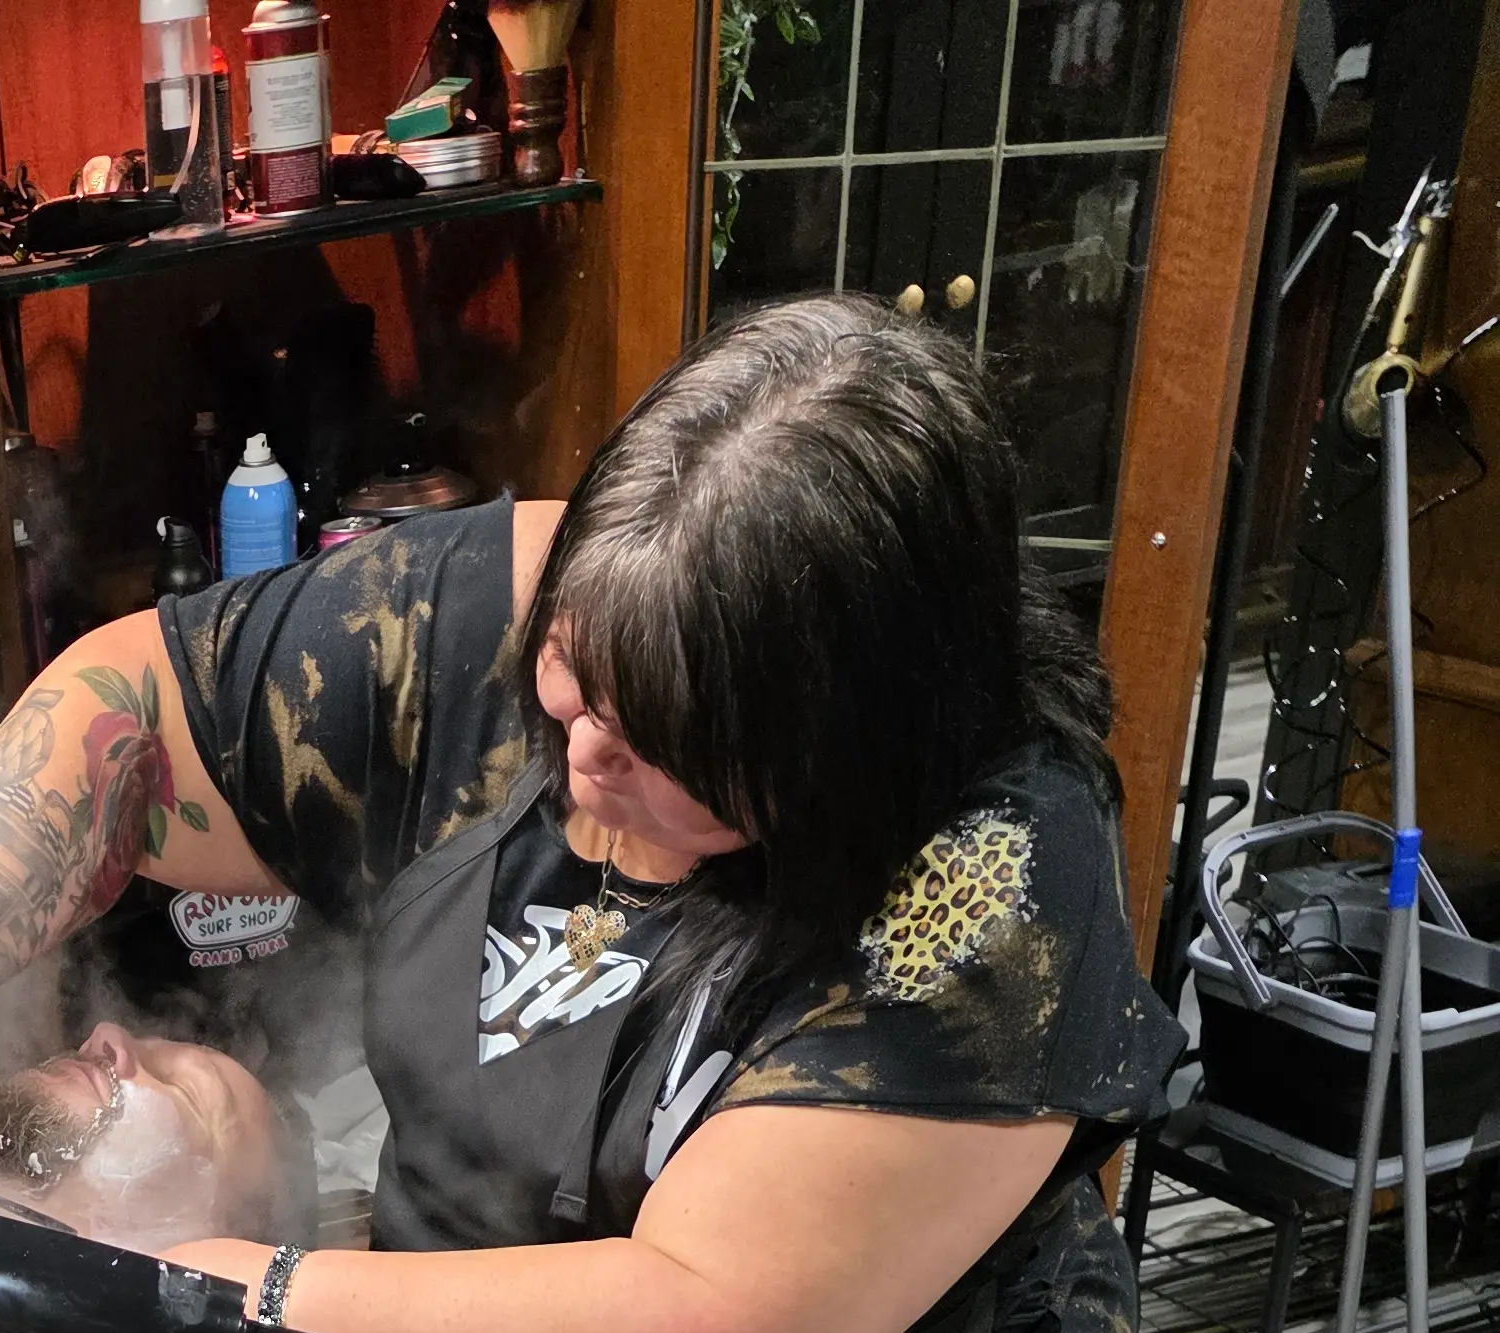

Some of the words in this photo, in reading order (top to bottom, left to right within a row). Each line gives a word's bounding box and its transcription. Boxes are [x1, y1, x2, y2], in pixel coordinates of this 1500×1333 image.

[198, 917, 233, 938] SURF
[239, 908, 278, 930] SHOP
[189, 947, 243, 967] GRAND
[245, 933, 289, 960] TURK
